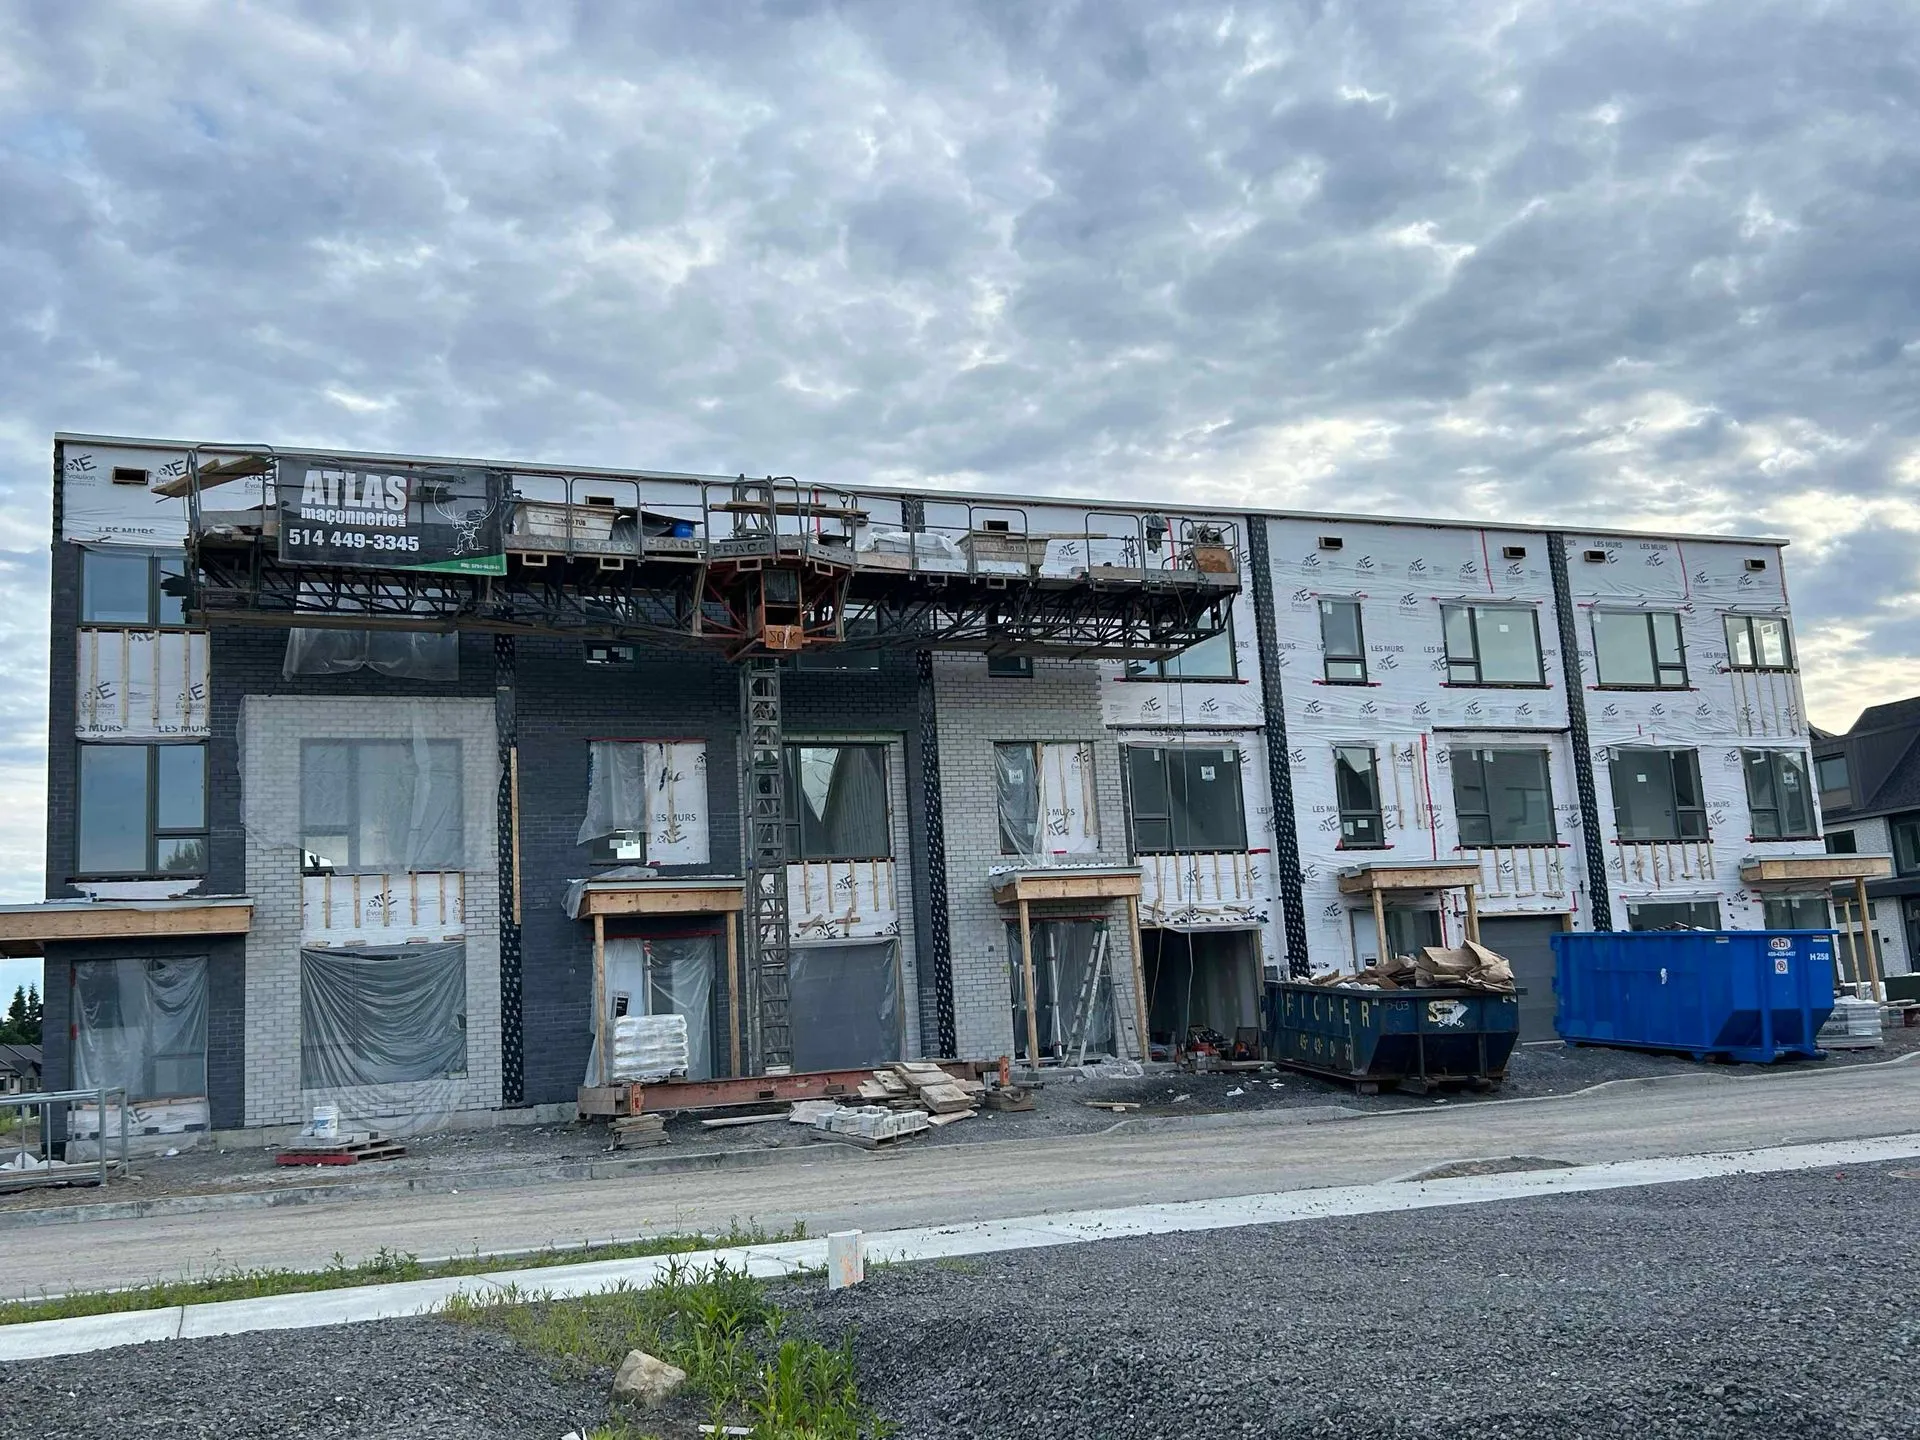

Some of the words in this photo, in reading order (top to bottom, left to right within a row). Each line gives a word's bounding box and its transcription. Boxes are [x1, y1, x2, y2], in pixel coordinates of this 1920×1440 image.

[300, 470, 407, 511] ATLAS
[300, 506, 398, 528] maçonnerie
[288, 528, 325, 546] 514
[330, 530, 419, 552] 449-3345
[1370, 645, 1383, 653] LES
[1384, 645, 1404, 653] MURS
[1423, 646, 1436, 654] LES
[158, 724, 178, 734] LES
